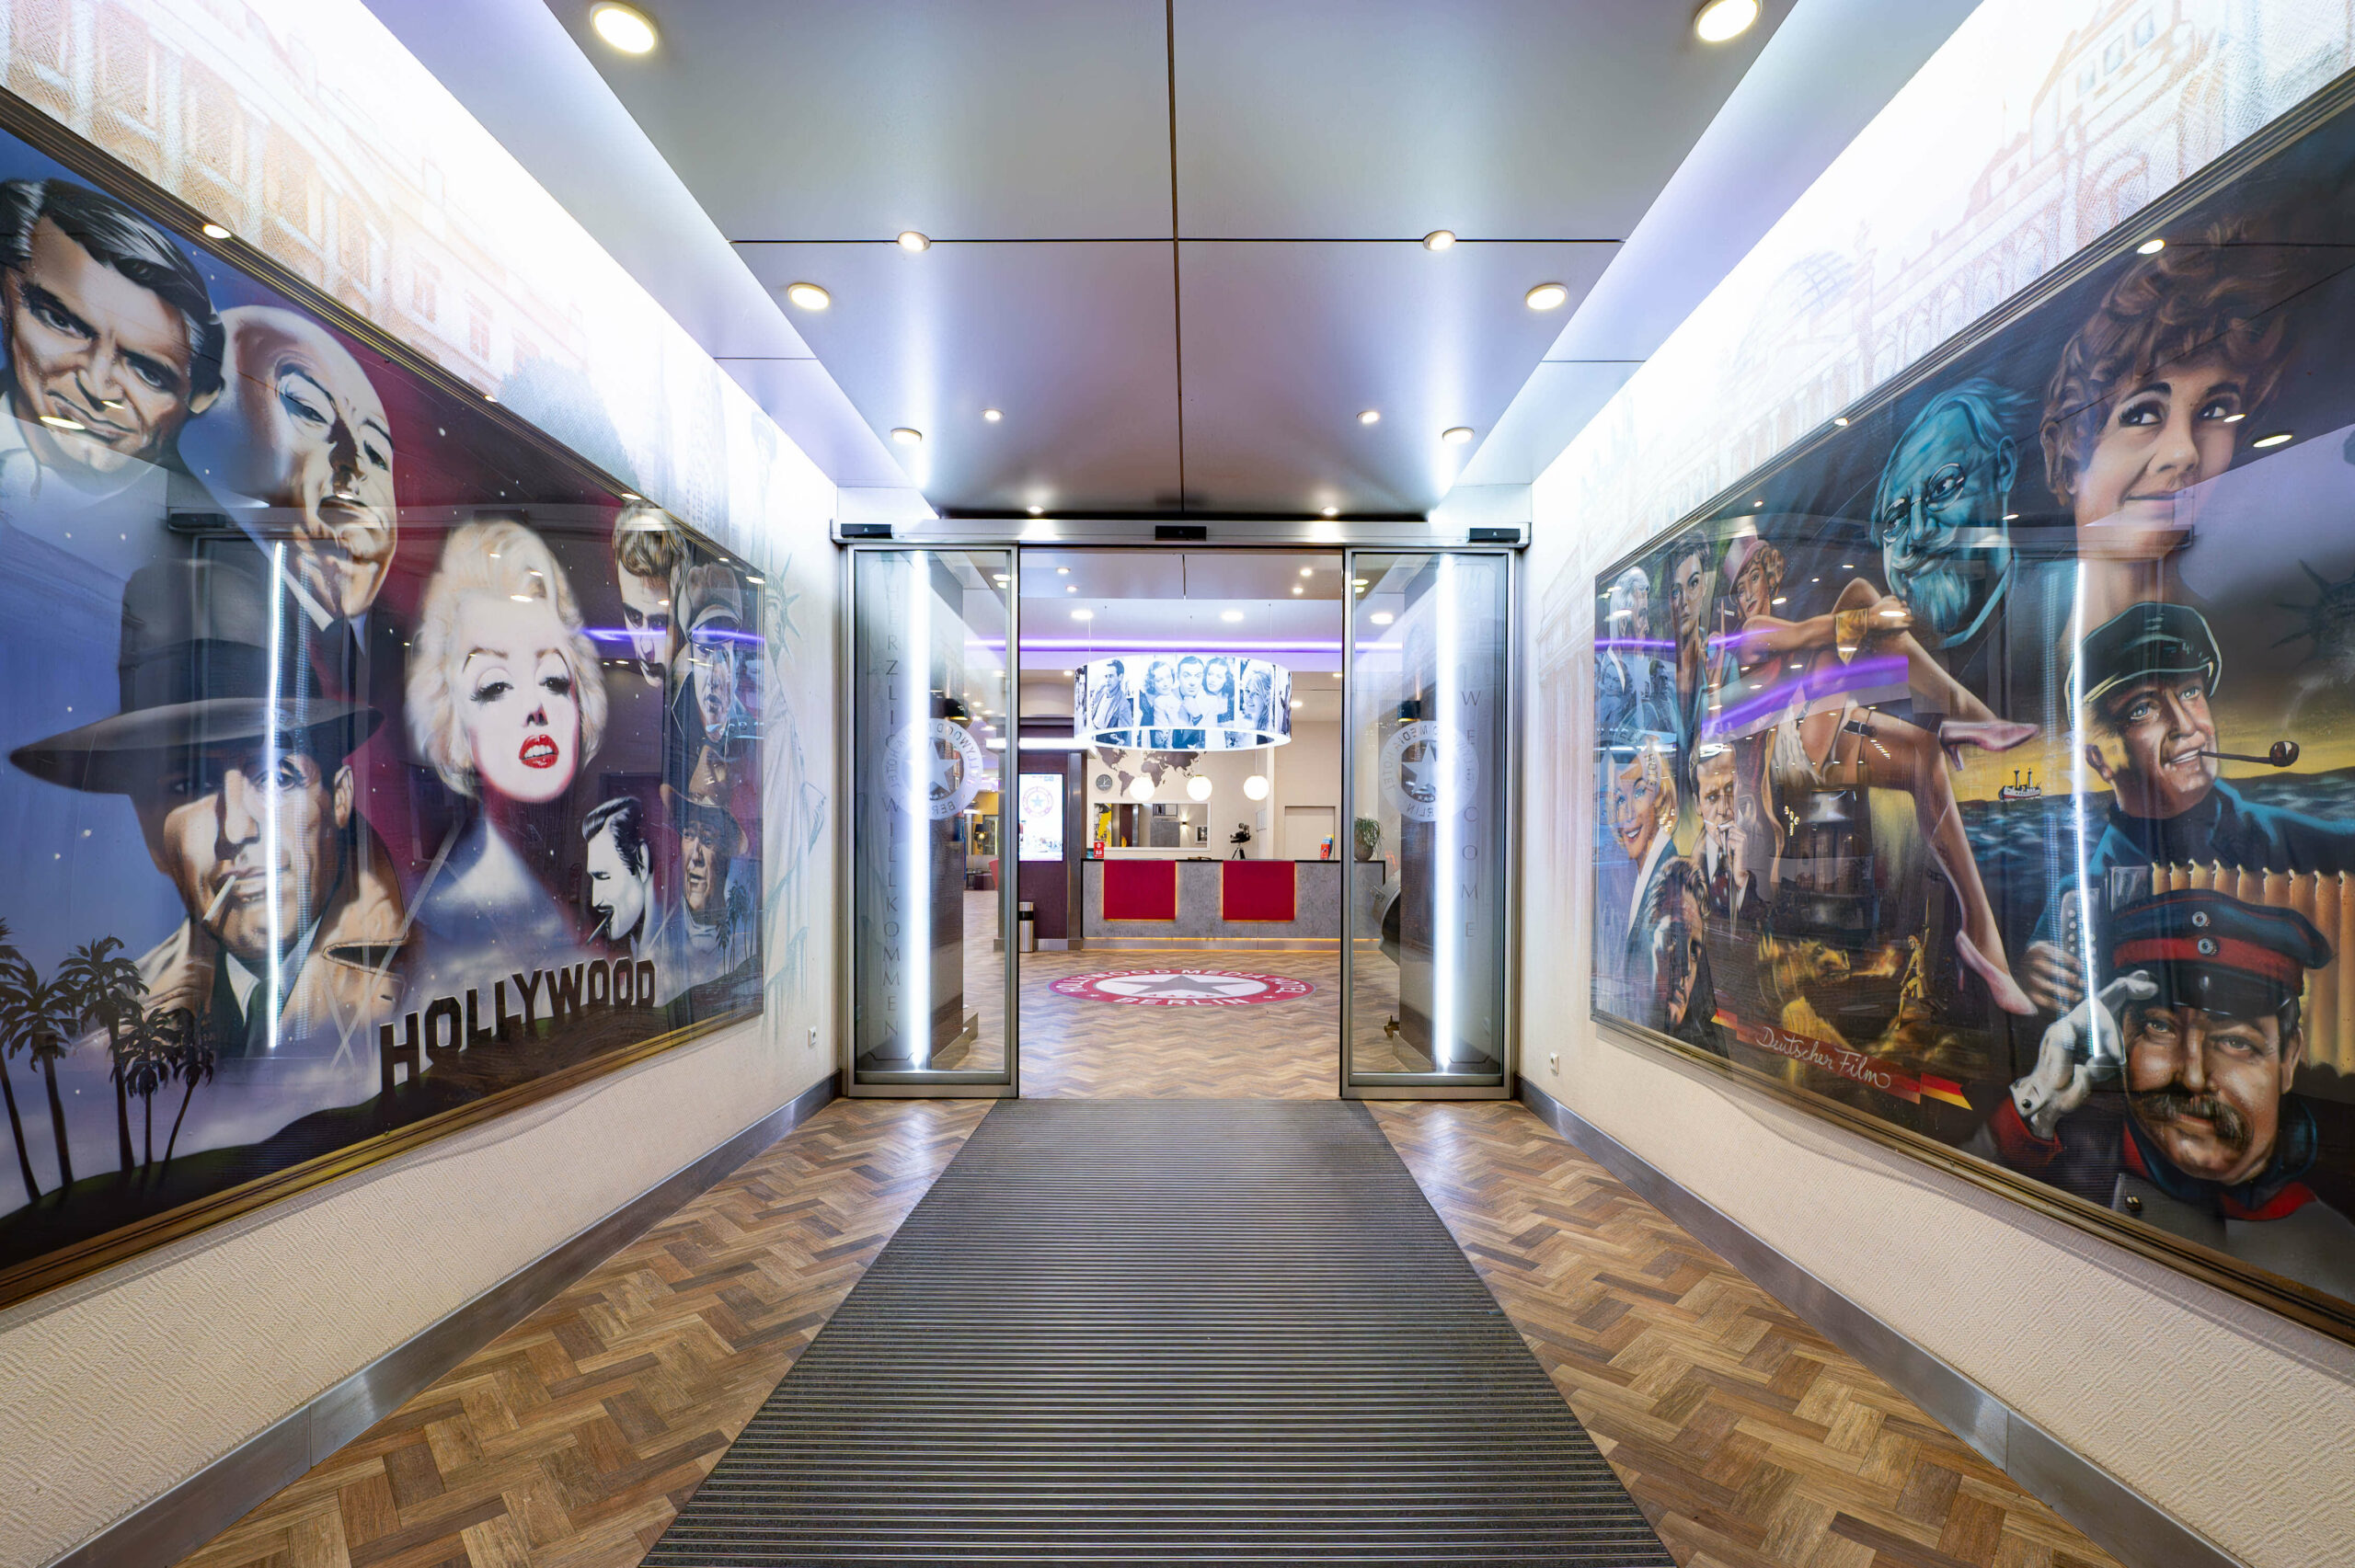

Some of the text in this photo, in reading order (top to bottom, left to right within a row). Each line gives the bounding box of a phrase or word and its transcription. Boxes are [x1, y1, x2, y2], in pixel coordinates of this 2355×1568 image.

[881, 796, 900, 1036] WILLKOMMEN
[1055, 969, 1306, 993] HOLLYWOOD MEDIA HOTEL
[1112, 997, 1250, 1006] BERLIN
[380, 957, 656, 1096] HOLLYWOOD
[1756, 1026, 1891, 1089] Deutscher Film
